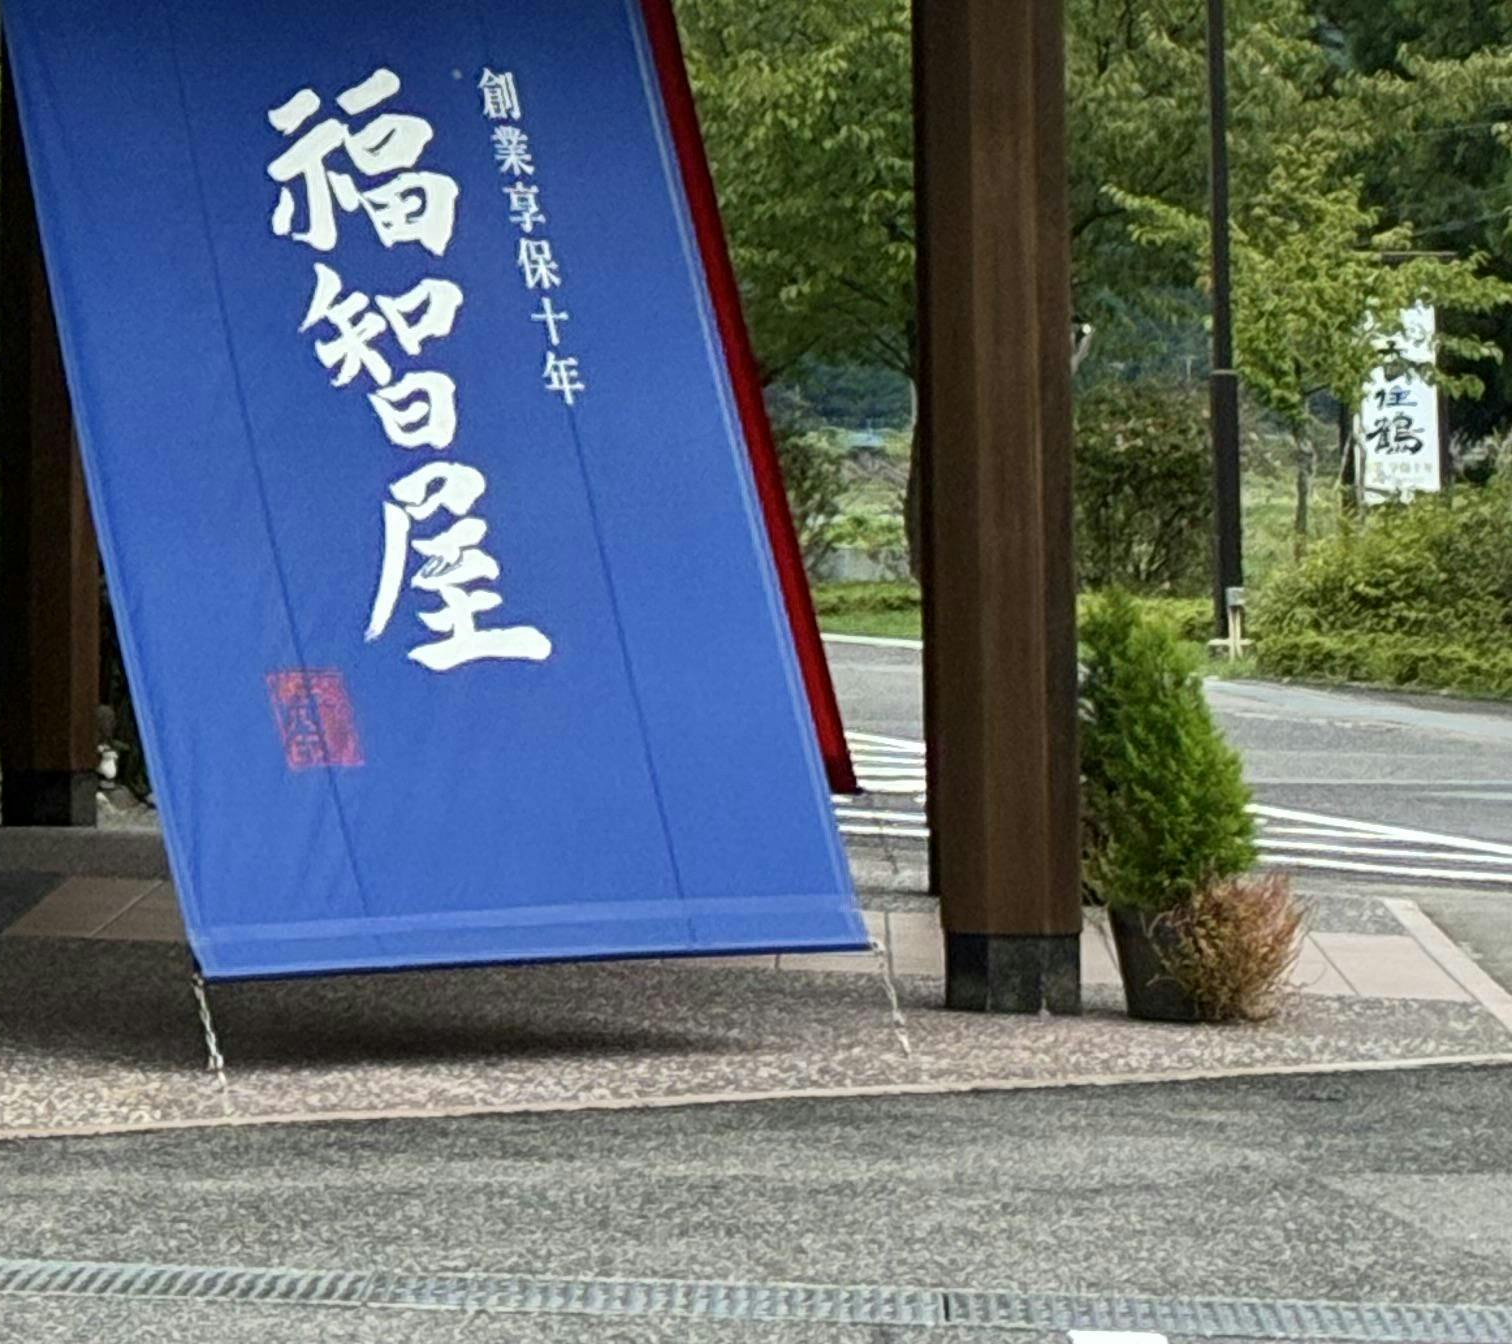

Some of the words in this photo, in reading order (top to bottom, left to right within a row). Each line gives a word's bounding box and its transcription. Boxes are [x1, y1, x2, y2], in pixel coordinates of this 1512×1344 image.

[266, 67, 554, 671] 福智屋
[477, 66, 586, 406] 創業享保十年
